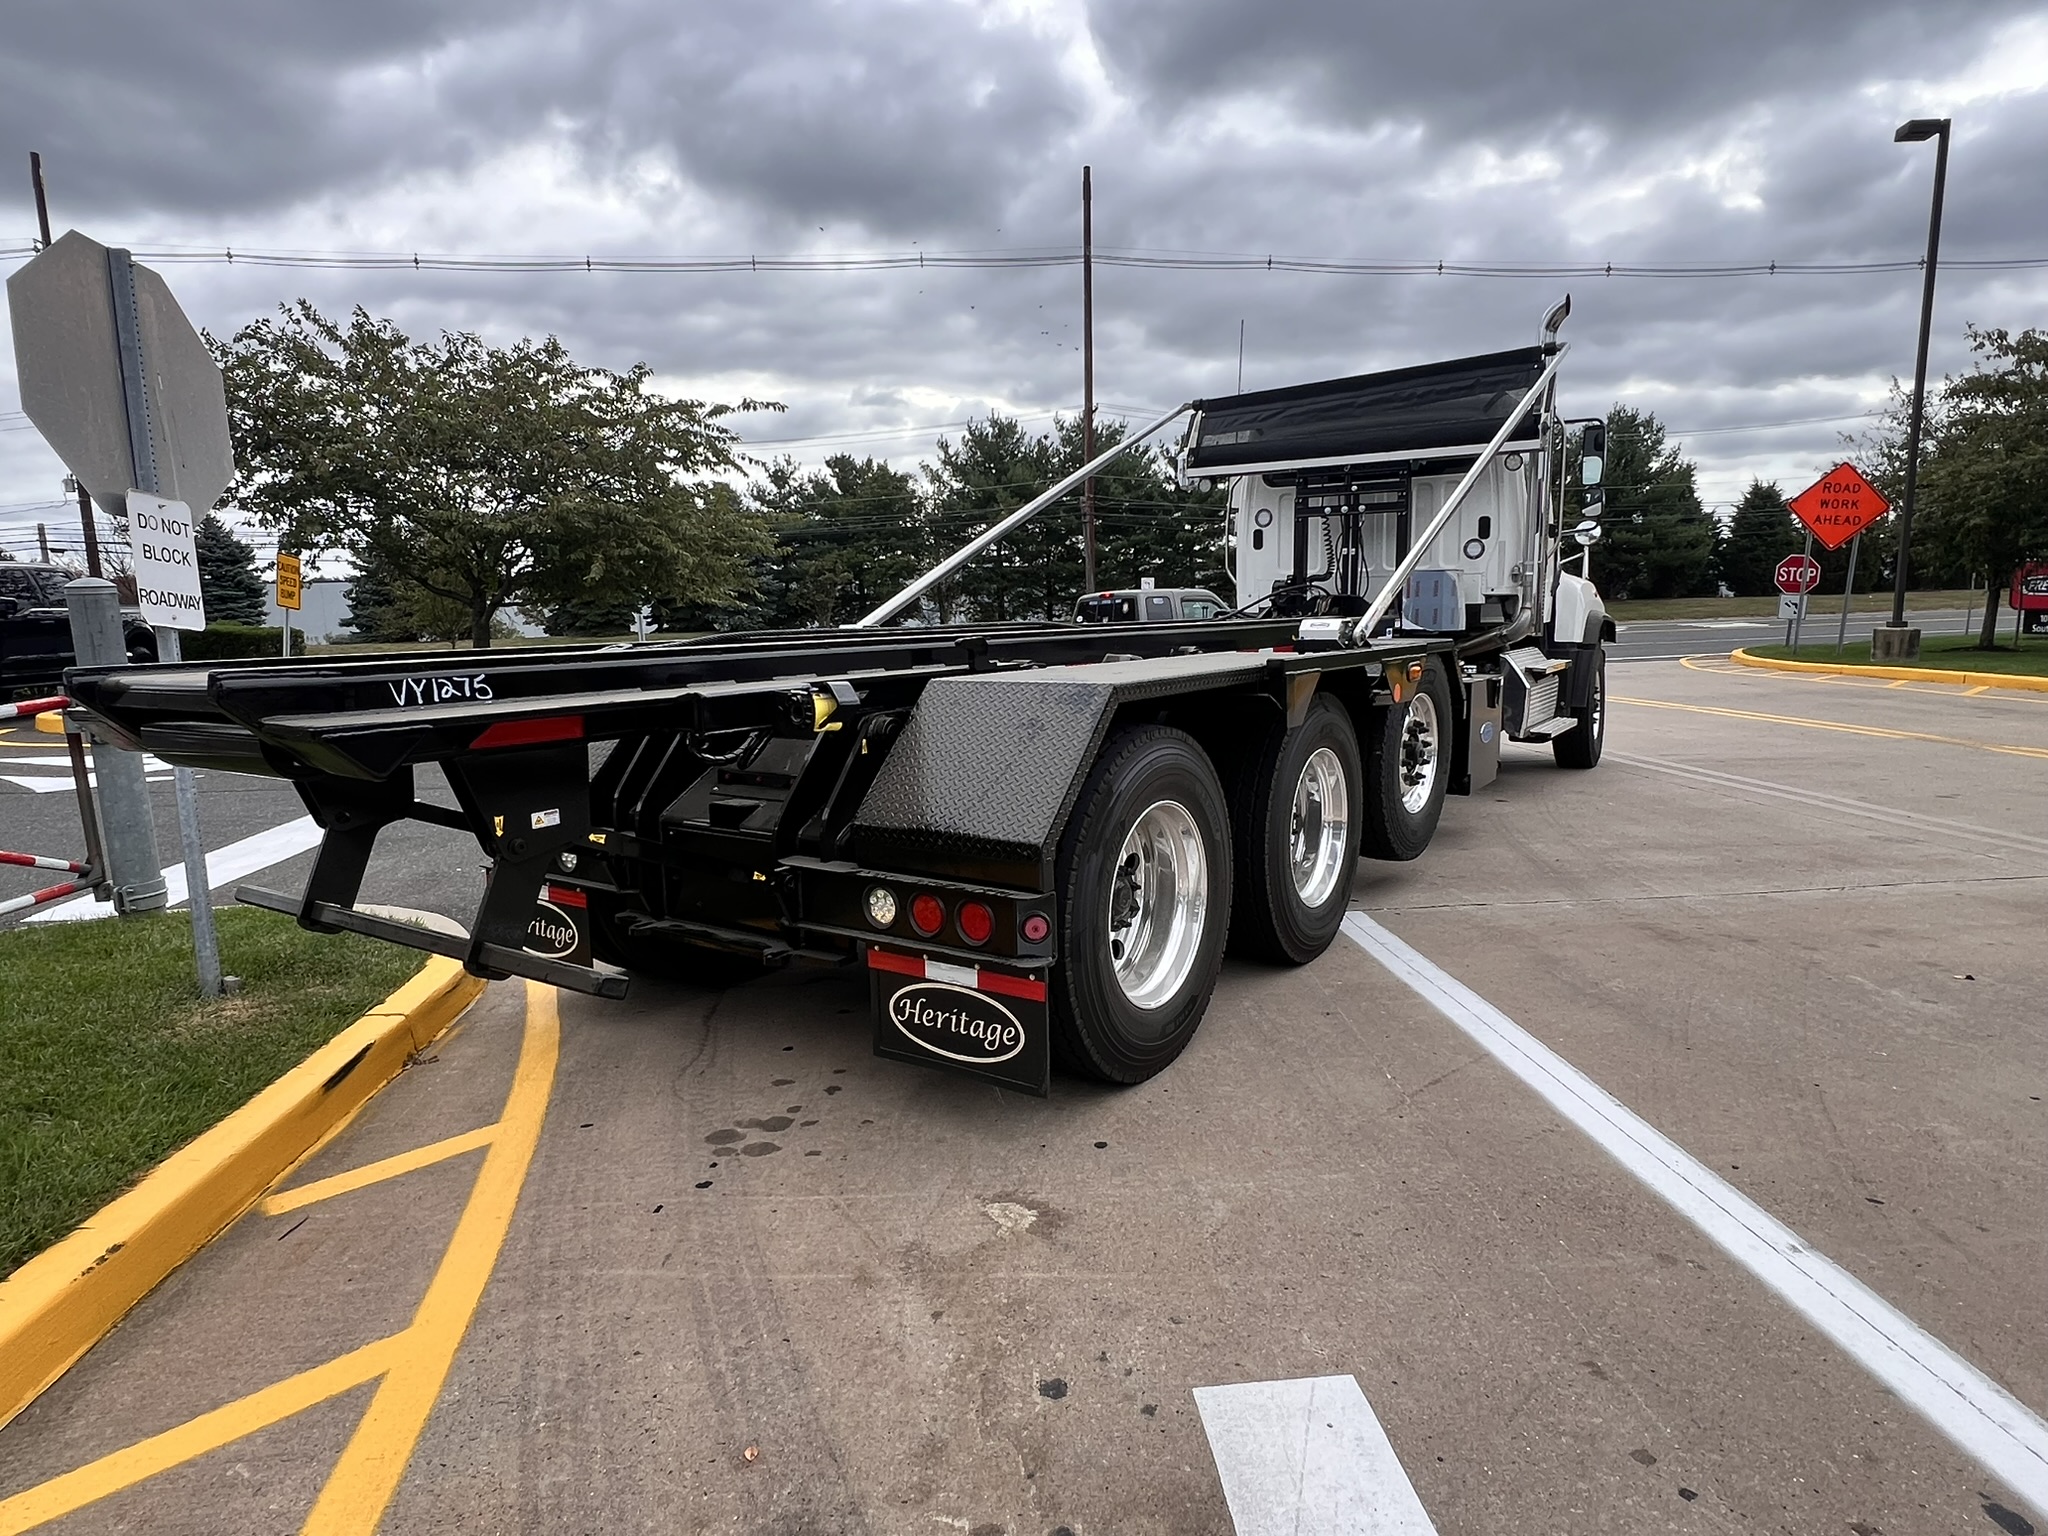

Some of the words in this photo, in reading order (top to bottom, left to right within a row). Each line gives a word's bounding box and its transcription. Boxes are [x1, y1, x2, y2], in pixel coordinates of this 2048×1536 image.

[1822, 482, 1861, 494] ROAD
[1820, 499, 1859, 510] WORK
[137, 512, 158, 531] DO
[161, 519, 190, 538] NOT
[1813, 515, 1862, 526] AHEAD
[142, 543, 192, 567] BLOCK
[280, 575, 297, 588] SPEED
[1778, 567, 1817, 582] STOP
[139, 588, 201, 610] ROADWAY
[388, 673, 493, 706] VY1275
[897, 998, 1016, 1051] Heritage
